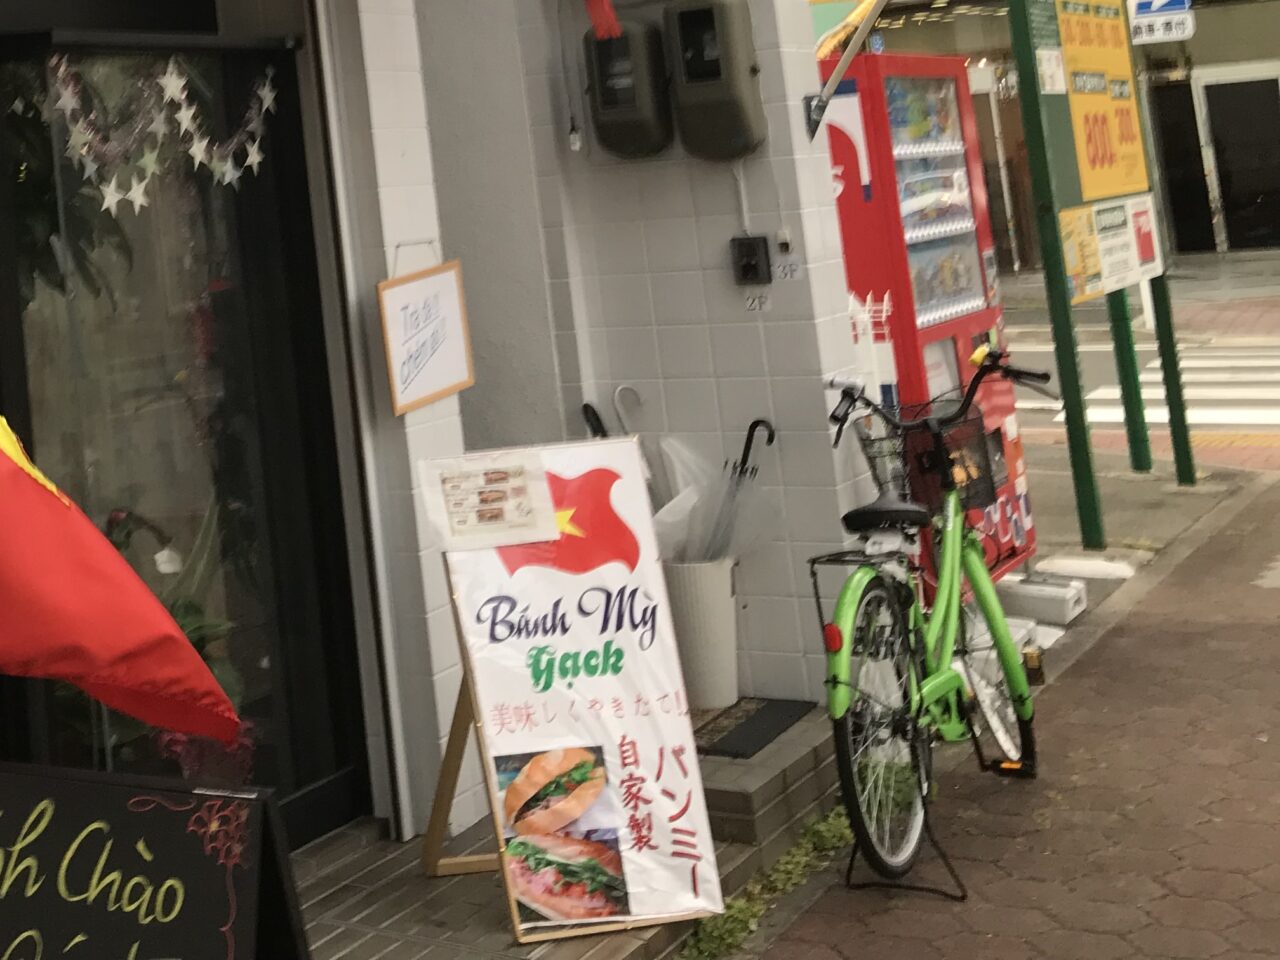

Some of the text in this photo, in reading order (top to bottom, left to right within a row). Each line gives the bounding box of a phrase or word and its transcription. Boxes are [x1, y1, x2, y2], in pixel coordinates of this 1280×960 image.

[476, 594, 573, 645] Bánh
[618, 733, 659, 853] 自家製
